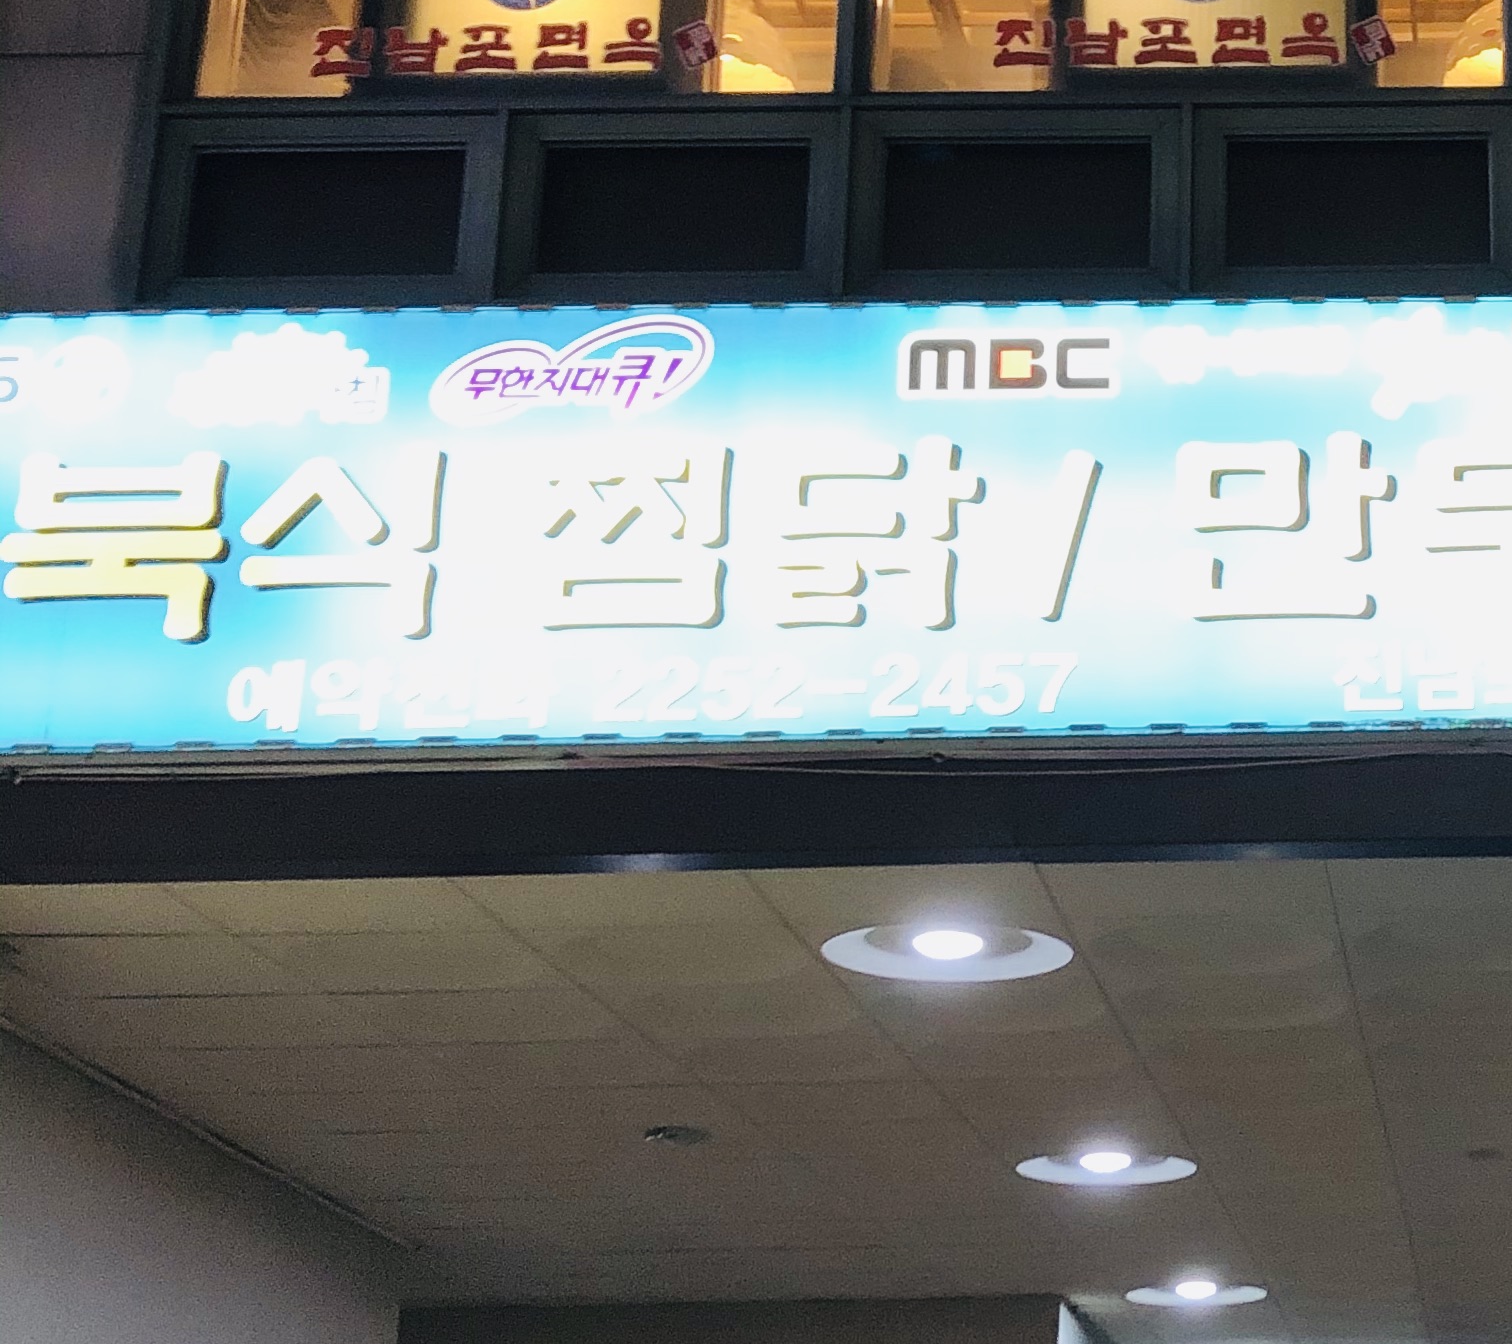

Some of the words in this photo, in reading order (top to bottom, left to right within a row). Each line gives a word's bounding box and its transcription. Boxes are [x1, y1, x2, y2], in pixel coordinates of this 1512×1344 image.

[309, 16, 663, 78] 진남포면옥
[992, 10, 1343, 69] 진남포면옥
[592, 650, 1080, 724] 2252-2457
